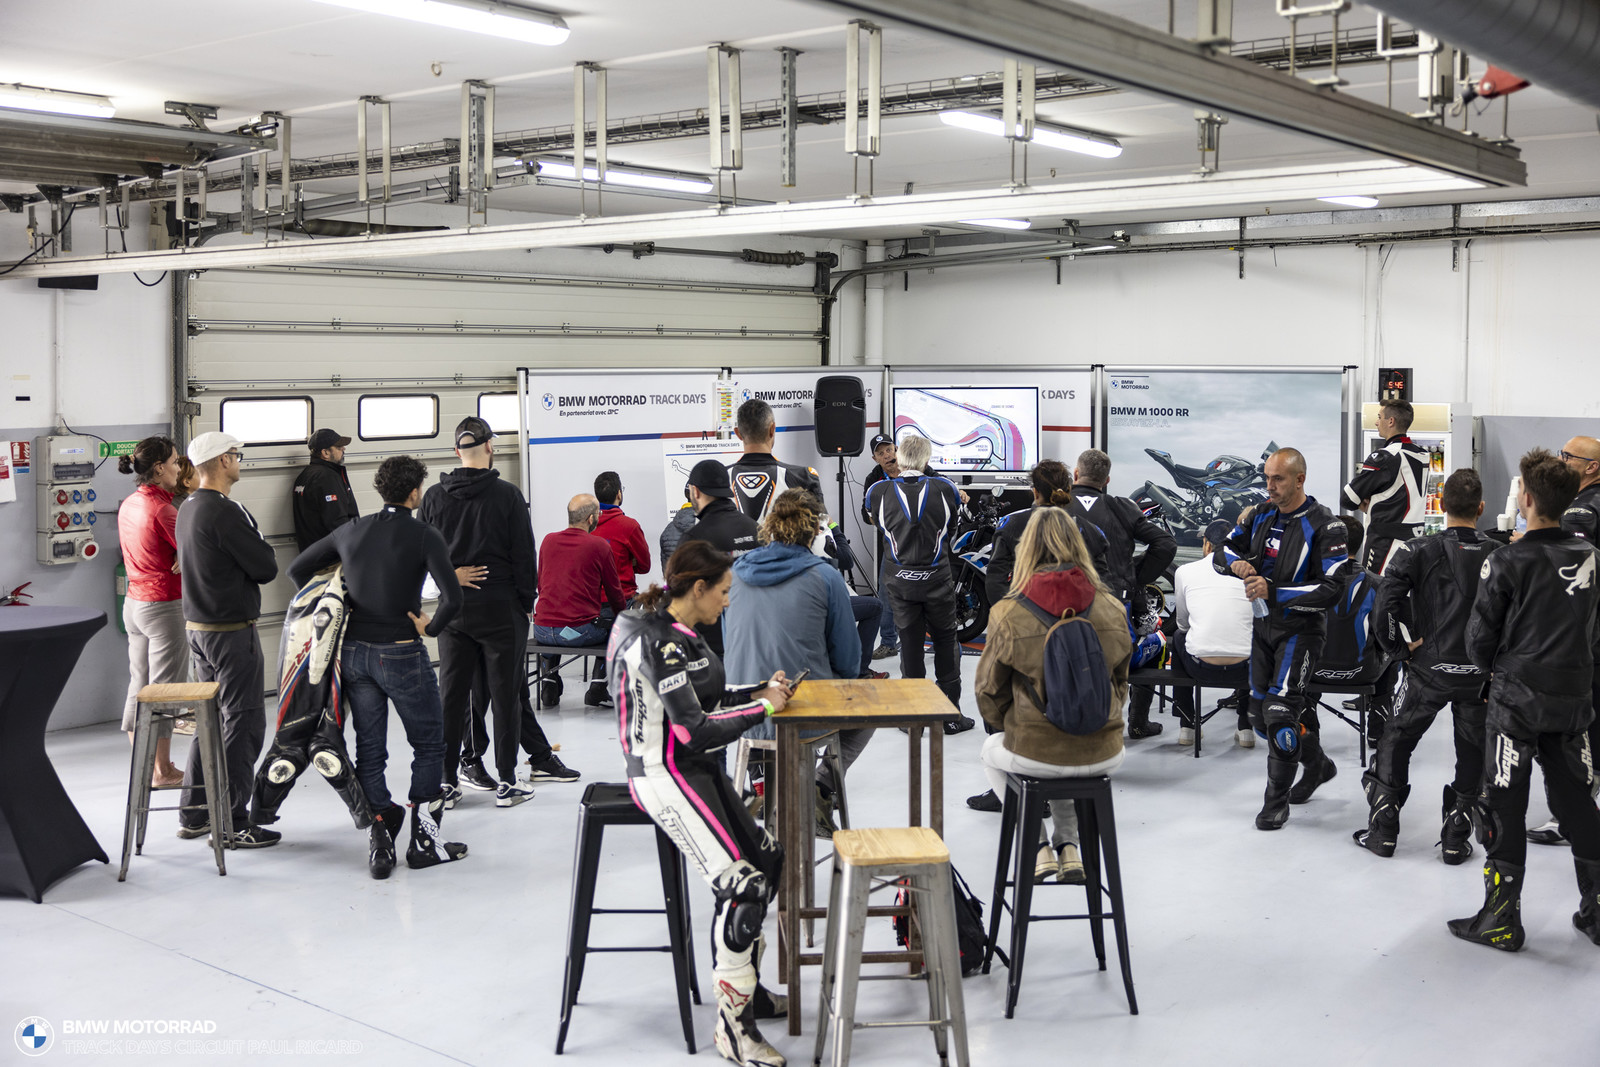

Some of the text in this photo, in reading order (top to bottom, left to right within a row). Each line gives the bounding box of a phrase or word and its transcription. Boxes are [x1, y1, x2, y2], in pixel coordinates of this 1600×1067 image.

[755, 390, 816, 400] BMW MOTORR
[1048, 390, 1075, 400] DAYS
[558, 394, 706, 407] BMW MOTORRAD TRACK DAYS
[1110, 407, 1136, 415] BMW
[1149, 408, 1174, 416] 1000
[1176, 408, 1189, 416] RR
[895, 569, 938, 580] RST
[1315, 666, 1363, 679] RST
